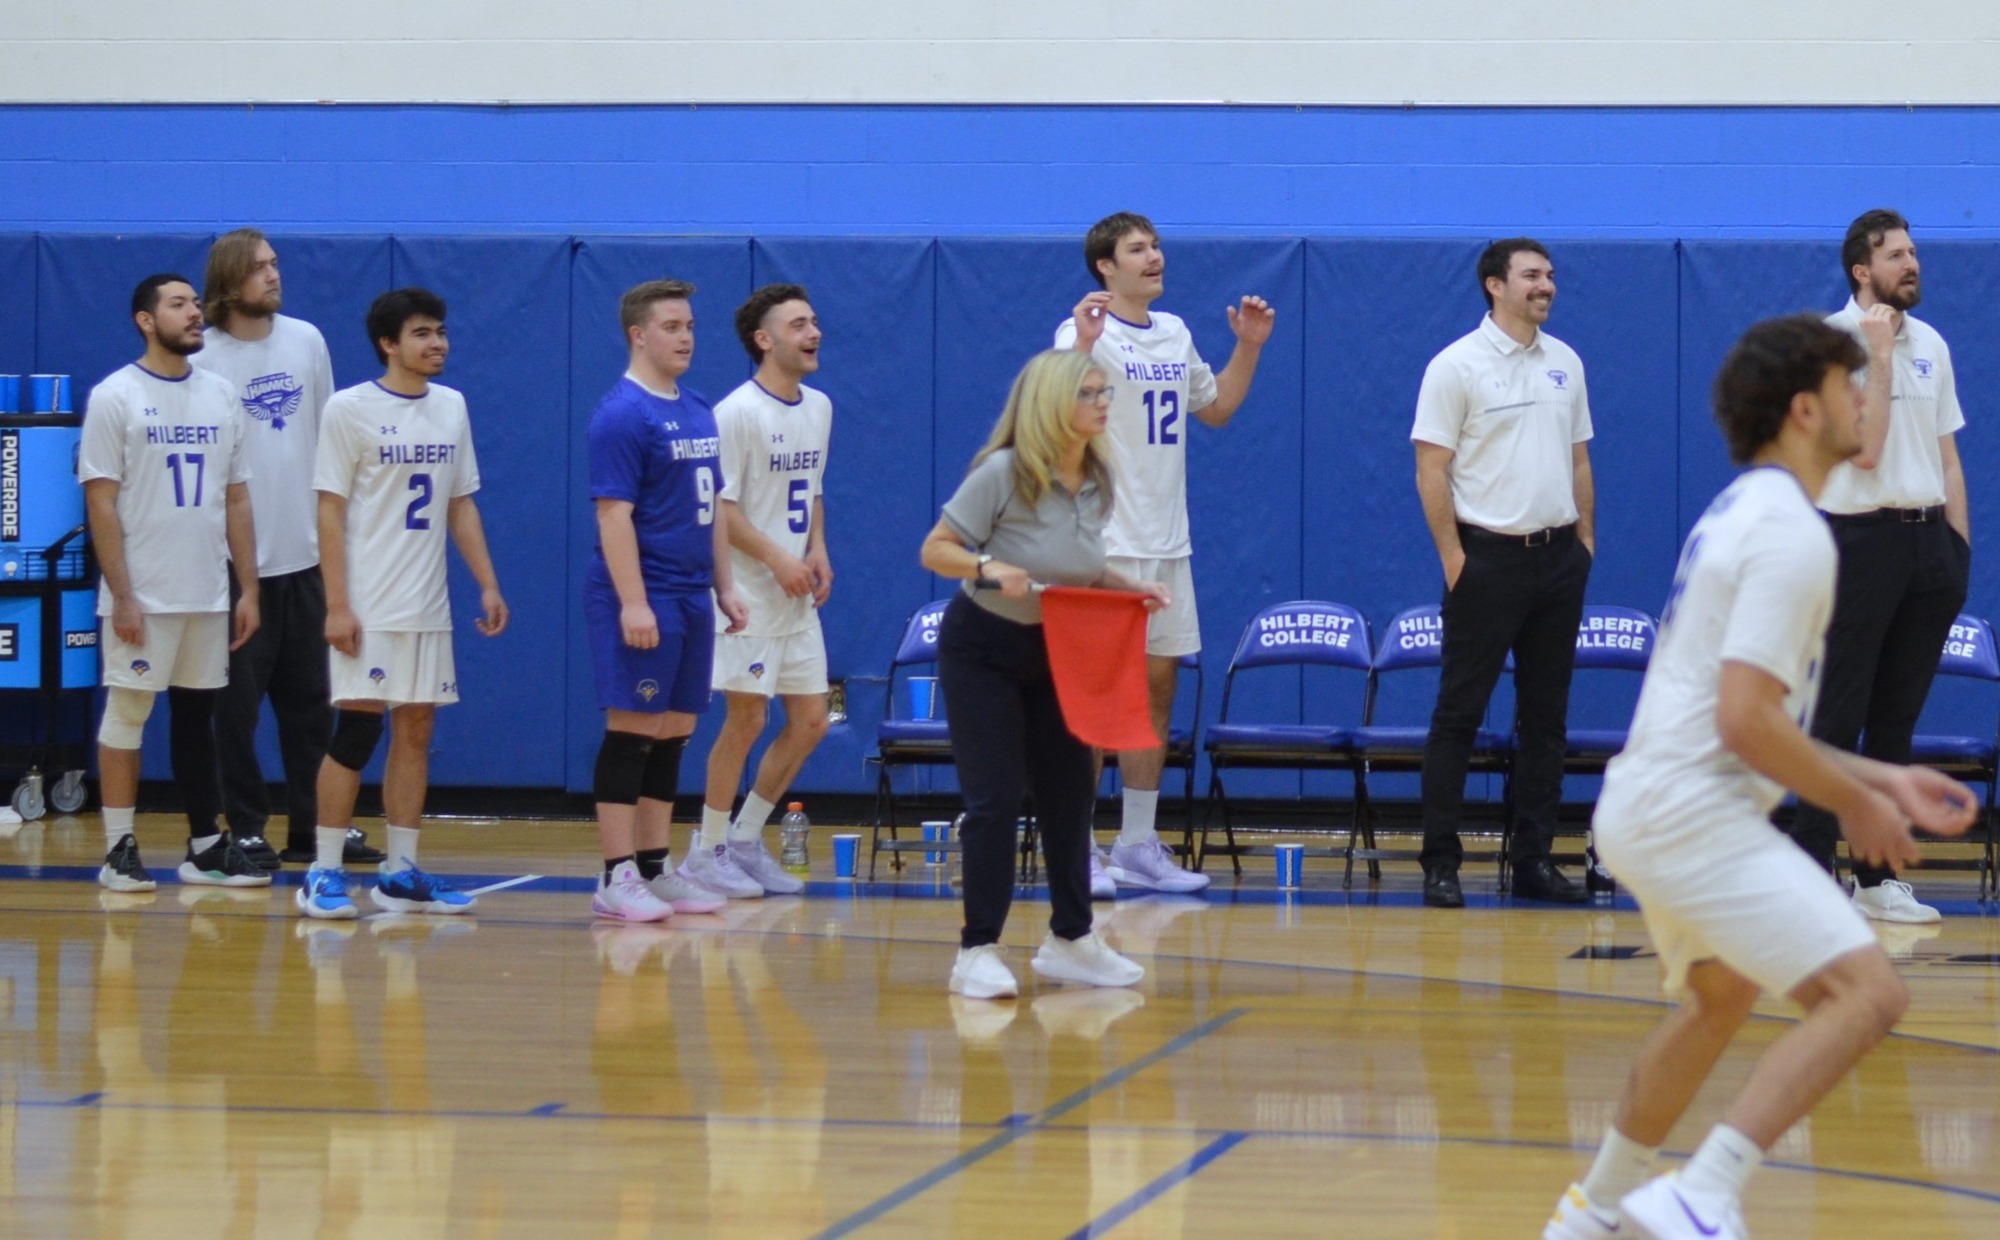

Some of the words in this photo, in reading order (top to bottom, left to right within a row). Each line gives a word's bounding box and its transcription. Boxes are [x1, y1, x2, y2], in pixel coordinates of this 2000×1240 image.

[1125, 362, 1186, 381] HILBERT
[146, 425, 219, 444] HILBERT
[1142, 390, 1178, 445] 12
[379, 444, 456, 465] HILBERT
[769, 449, 821, 472] HILBER
[2, 435, 18, 537] POWERADE
[166, 453, 205, 507] 17
[696, 466, 715, 525] 9
[406, 473, 433, 530] 2
[788, 479, 809, 534] 5
[1260, 613, 1355, 631] HILBERT
[1260, 629, 1351, 648] COLLEGE
